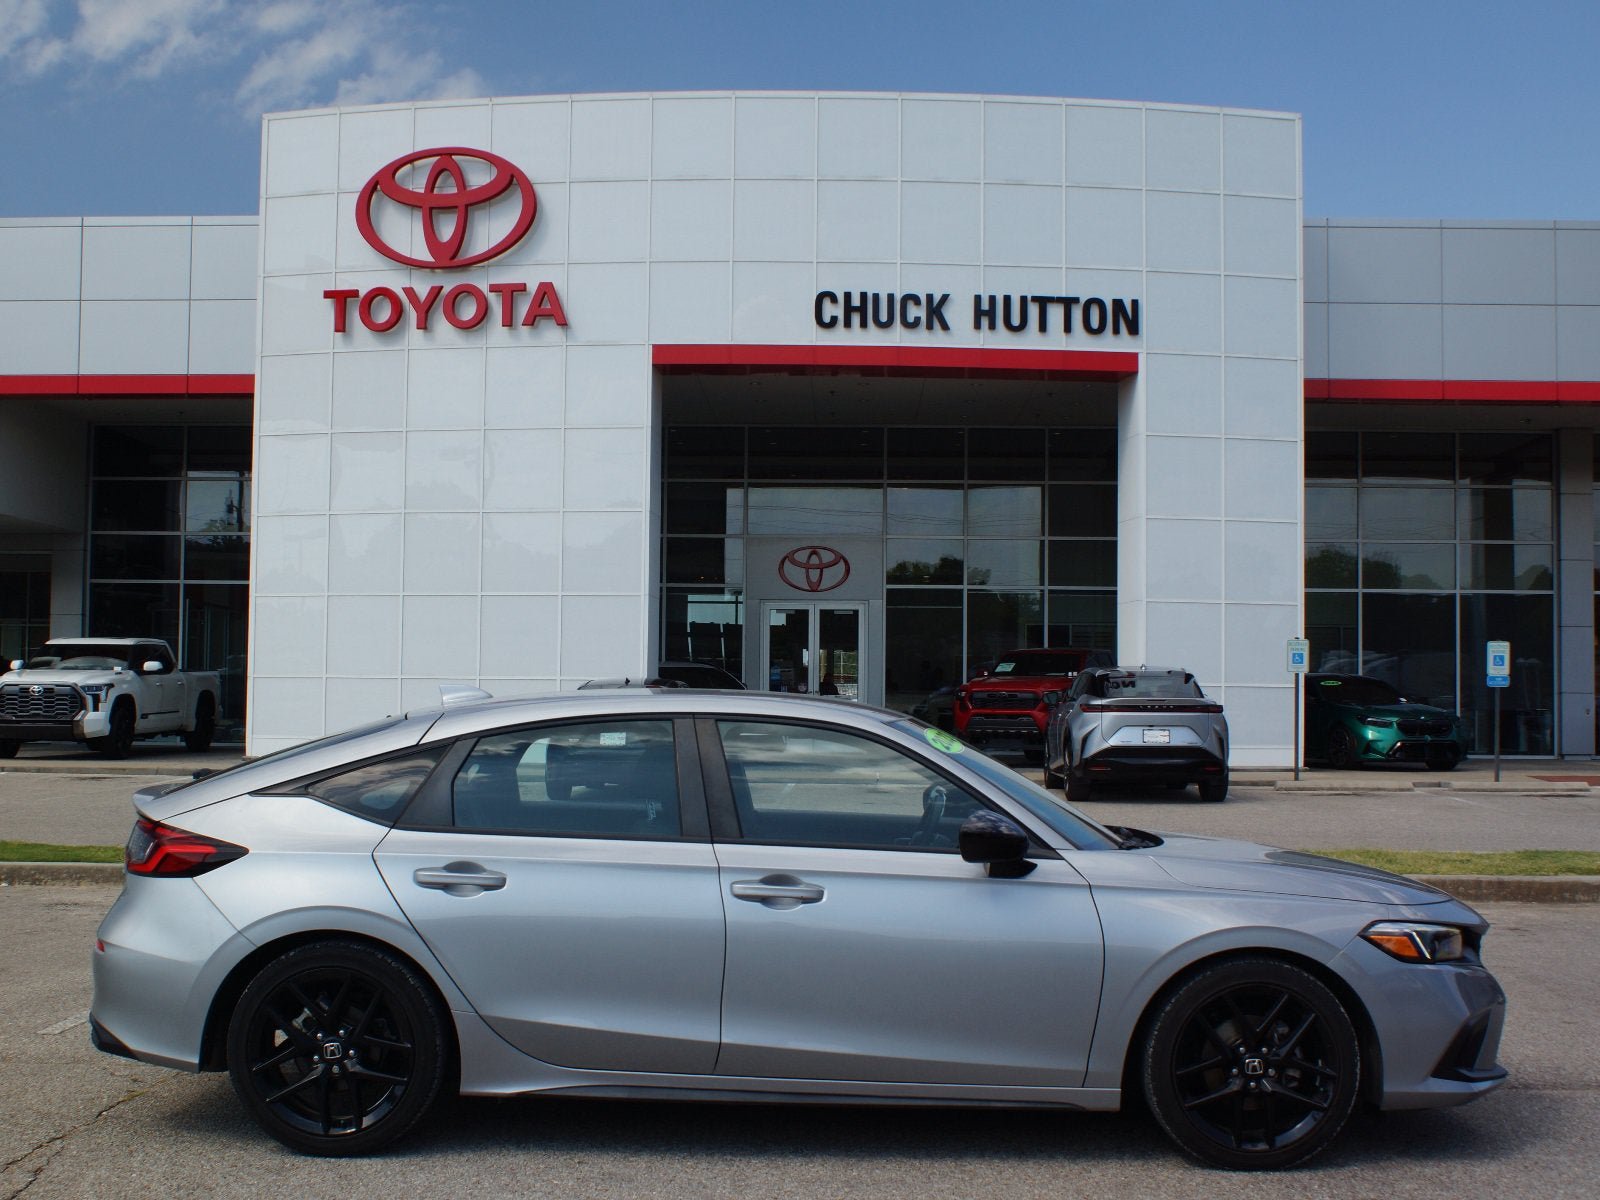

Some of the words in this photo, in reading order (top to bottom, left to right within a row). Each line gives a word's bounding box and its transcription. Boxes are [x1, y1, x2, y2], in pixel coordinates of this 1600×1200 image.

[323, 281, 568, 333] TOYOTA
[814, 290, 951, 331] CHUCK
[973, 294, 1139, 336] HUTTON
